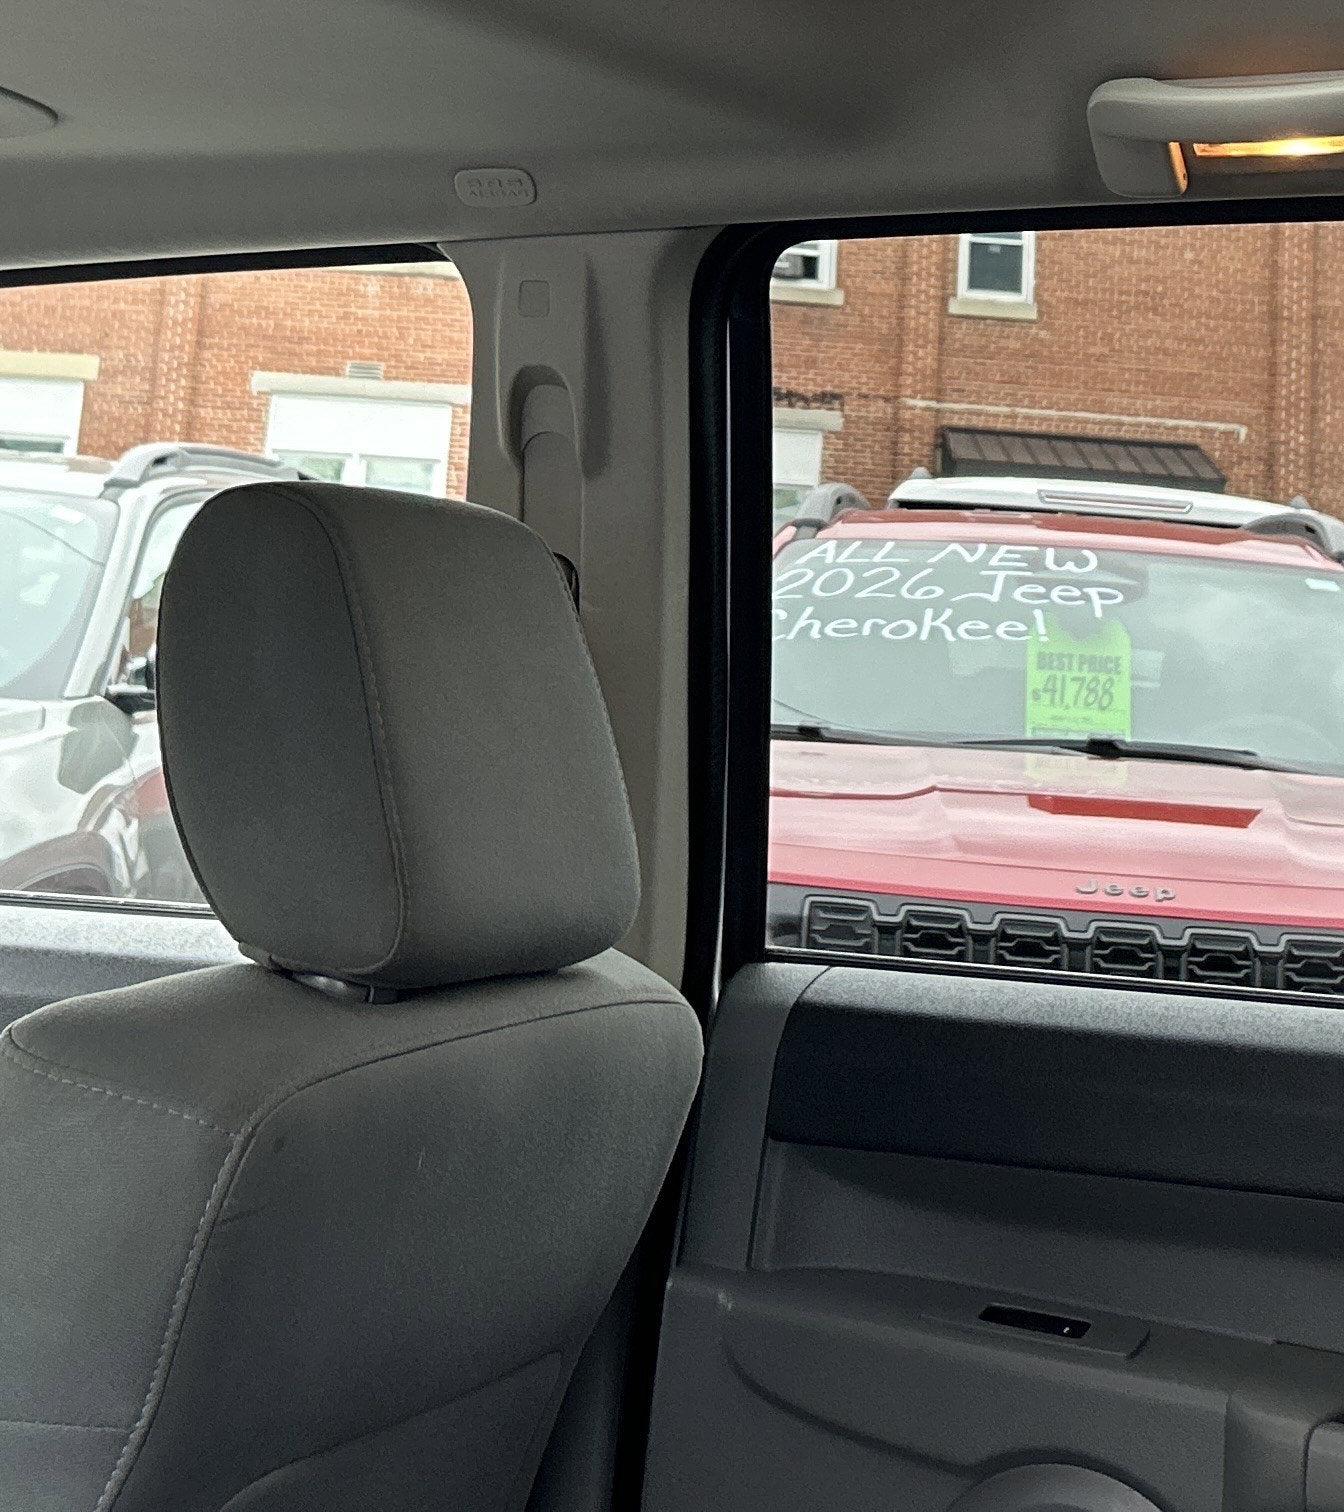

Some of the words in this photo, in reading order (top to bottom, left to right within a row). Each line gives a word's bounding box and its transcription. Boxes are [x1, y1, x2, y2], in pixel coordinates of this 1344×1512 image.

[794, 539, 910, 565] ALL
[927, 543, 1098, 574] NEW
[773, 566, 944, 600] 2026
[950, 569, 1125, 619] Jeep
[1036, 651, 1075, 671] BEST
[1077, 654, 1122, 675] PRICE
[1076, 879, 1176, 902] Jeep
